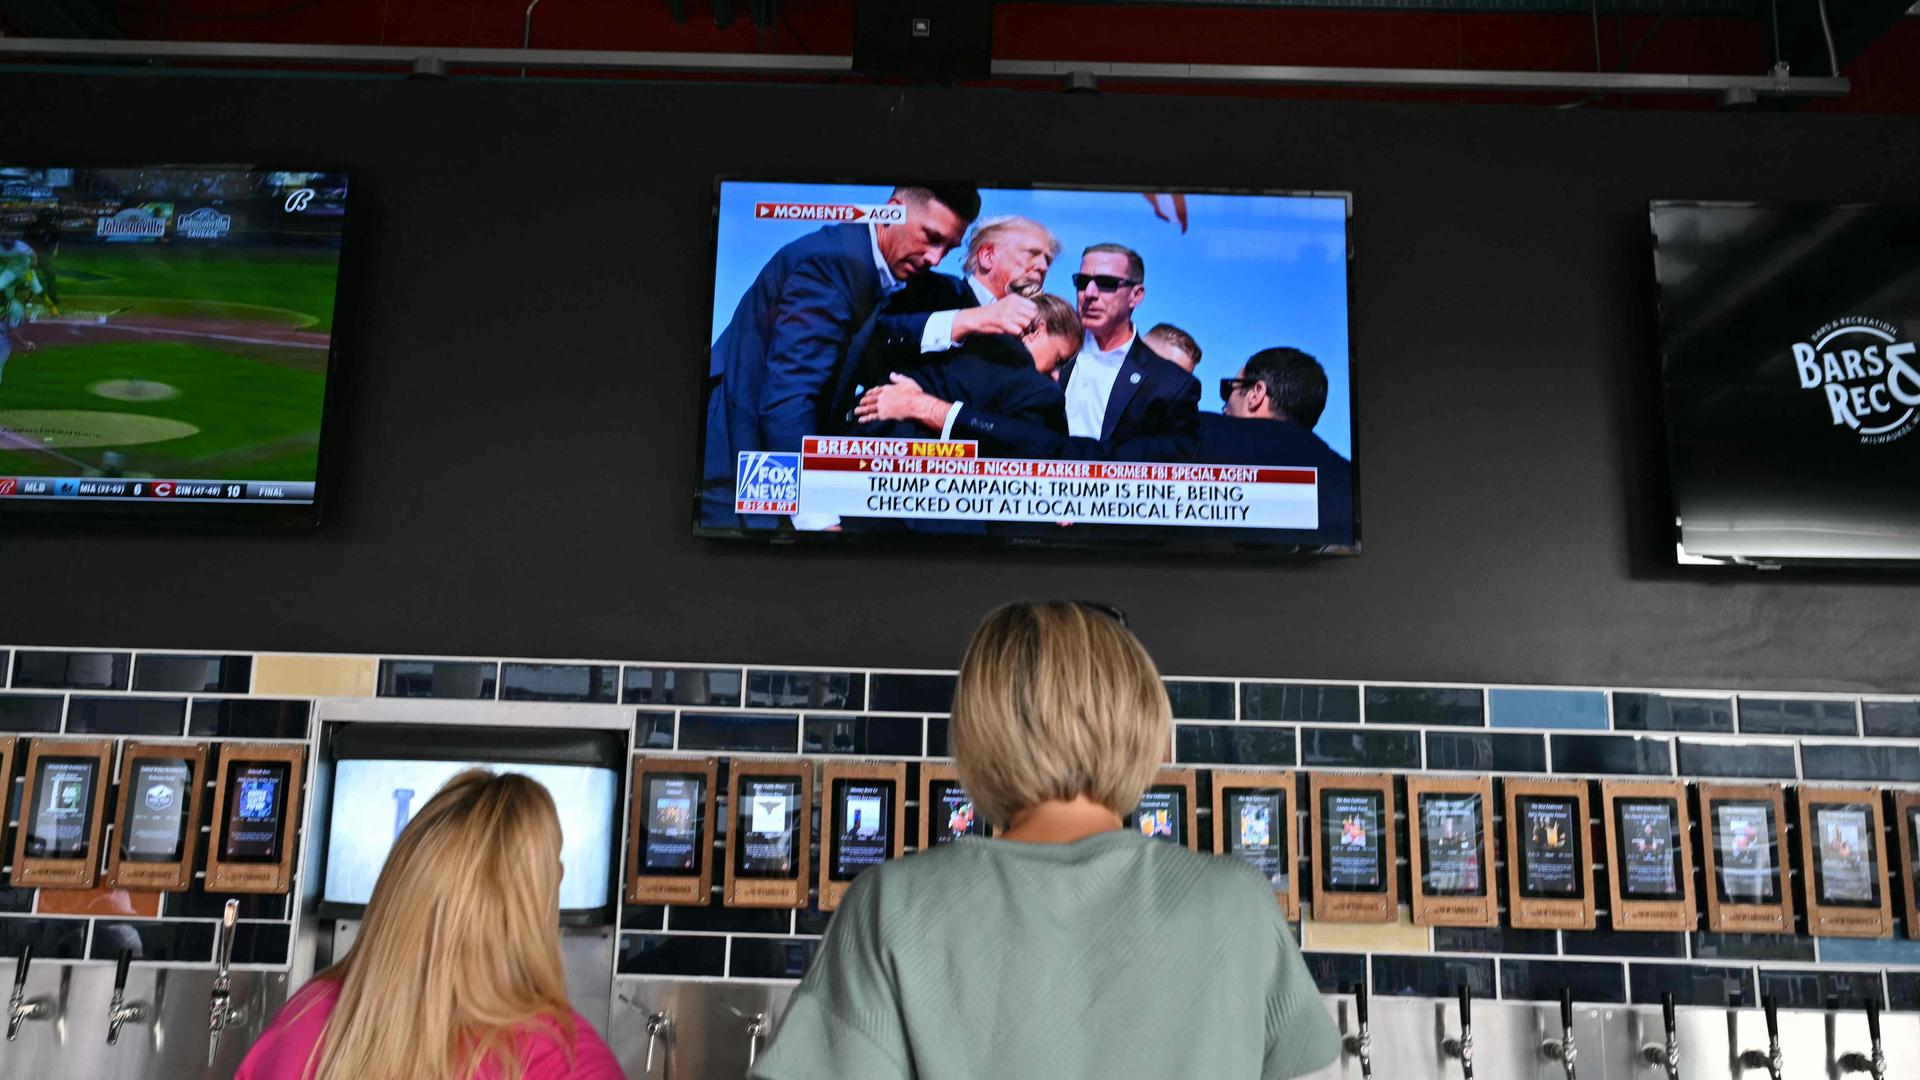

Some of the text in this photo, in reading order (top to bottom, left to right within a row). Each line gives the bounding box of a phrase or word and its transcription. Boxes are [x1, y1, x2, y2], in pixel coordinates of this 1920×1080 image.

[773, 205, 902, 220] MOMENTS AGO
[99, 220, 163, 236] Johnsonville
[1840, 316, 1898, 336] RECREATION
[1791, 341, 1885, 389] BARS
[1824, 382, 1891, 430] REC
[816, 440, 966, 458] BREAKING NEWS
[758, 466, 797, 484] FOX
[870, 459, 1260, 483] ON THE PHONE: NICOLE PARKER FORMER FBI SPECIAL AGENT
[24, 482, 46, 493] MLB
[79, 484, 96, 494] MIA
[175, 486, 192, 496] CIN
[226, 485, 241, 498] 10
[258, 487, 285, 498] FINAL
[746, 482, 797, 500] NEWS
[867, 476, 1244, 503] TRUMP CAMPAIGN: TRUMP IS FINE, BEING
[866, 495, 1250, 521] CHECKED OUT AT LOCAL MEDICAL FACILITY
